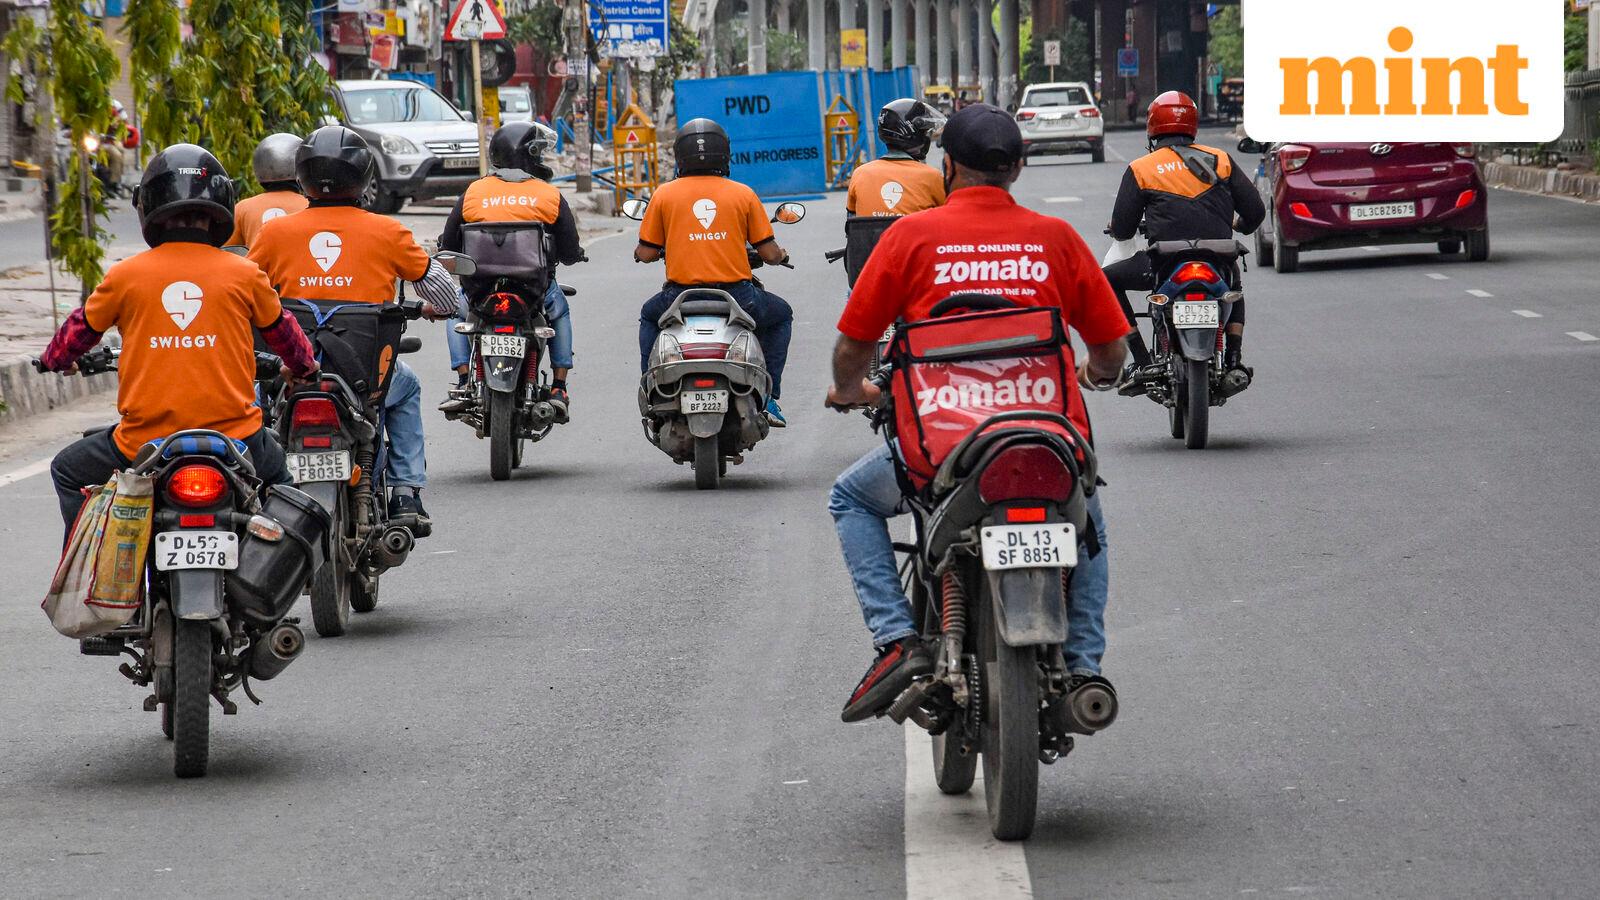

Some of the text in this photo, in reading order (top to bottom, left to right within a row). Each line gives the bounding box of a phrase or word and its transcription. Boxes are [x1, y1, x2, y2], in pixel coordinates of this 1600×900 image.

[632, 6, 661, 15] Centre
[724, 95, 770, 116] PWD
[754, 147, 819, 163] PROGRESS
[1157, 160, 1189, 174] SWI
[482, 195, 537, 208] SWIGGY
[688, 231, 727, 241] SWIGGY
[936, 244, 1043, 254] ORDER ONLINE ON
[934, 255, 1049, 285] zomato
[299, 276, 353, 287] SWIGGY
[1021, 288, 1037, 296] APP
[149, 334, 217, 349] SWIGGY
[490, 336, 522, 347] DL5SA
[695, 393, 705, 401] DL
[917, 372, 1056, 416] zomato
[298, 453, 343, 467] DL3SE
[299, 466, 344, 481] F8035
[1007, 529, 1052, 547] DL 13
[166, 552, 178, 567] Z
[998, 546, 1060, 565] SF 8851
